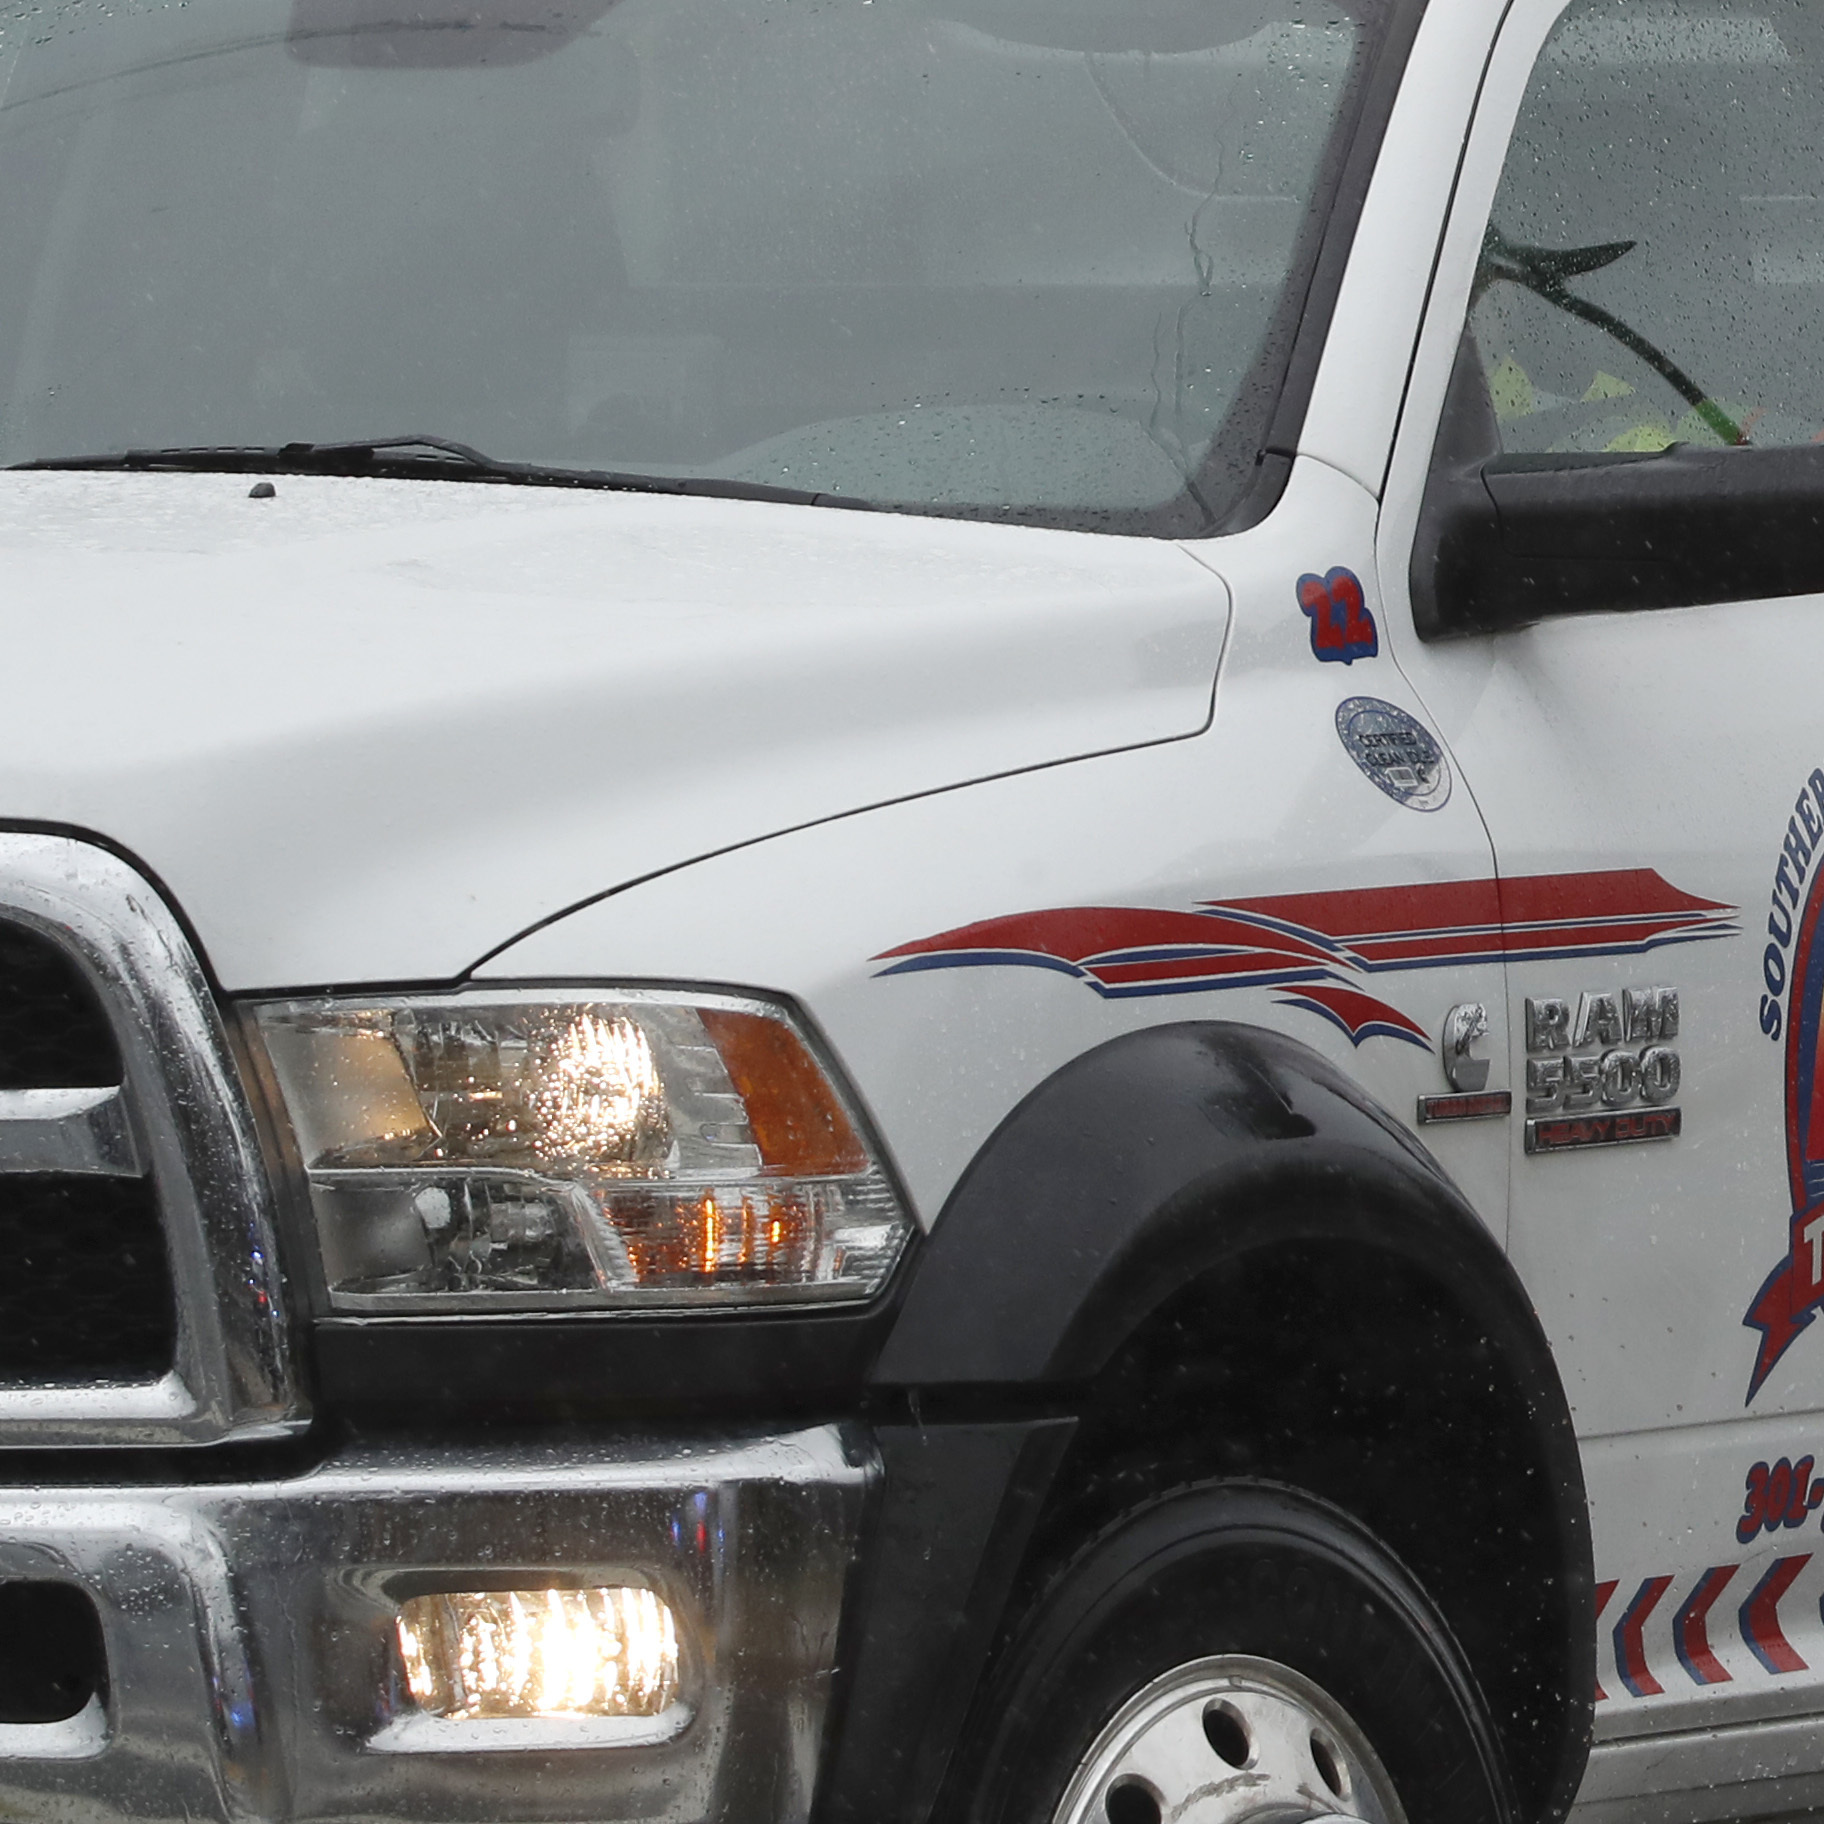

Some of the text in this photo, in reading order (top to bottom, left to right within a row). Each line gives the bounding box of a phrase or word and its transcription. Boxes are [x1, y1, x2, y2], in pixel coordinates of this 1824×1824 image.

[1296, 566, 1379, 665] 22
[1525, 986, 1680, 1053] RAM
[1526, 1047, 1682, 1113] 5500
[1539, 1114, 1677, 1145] HEAVY DUTY
